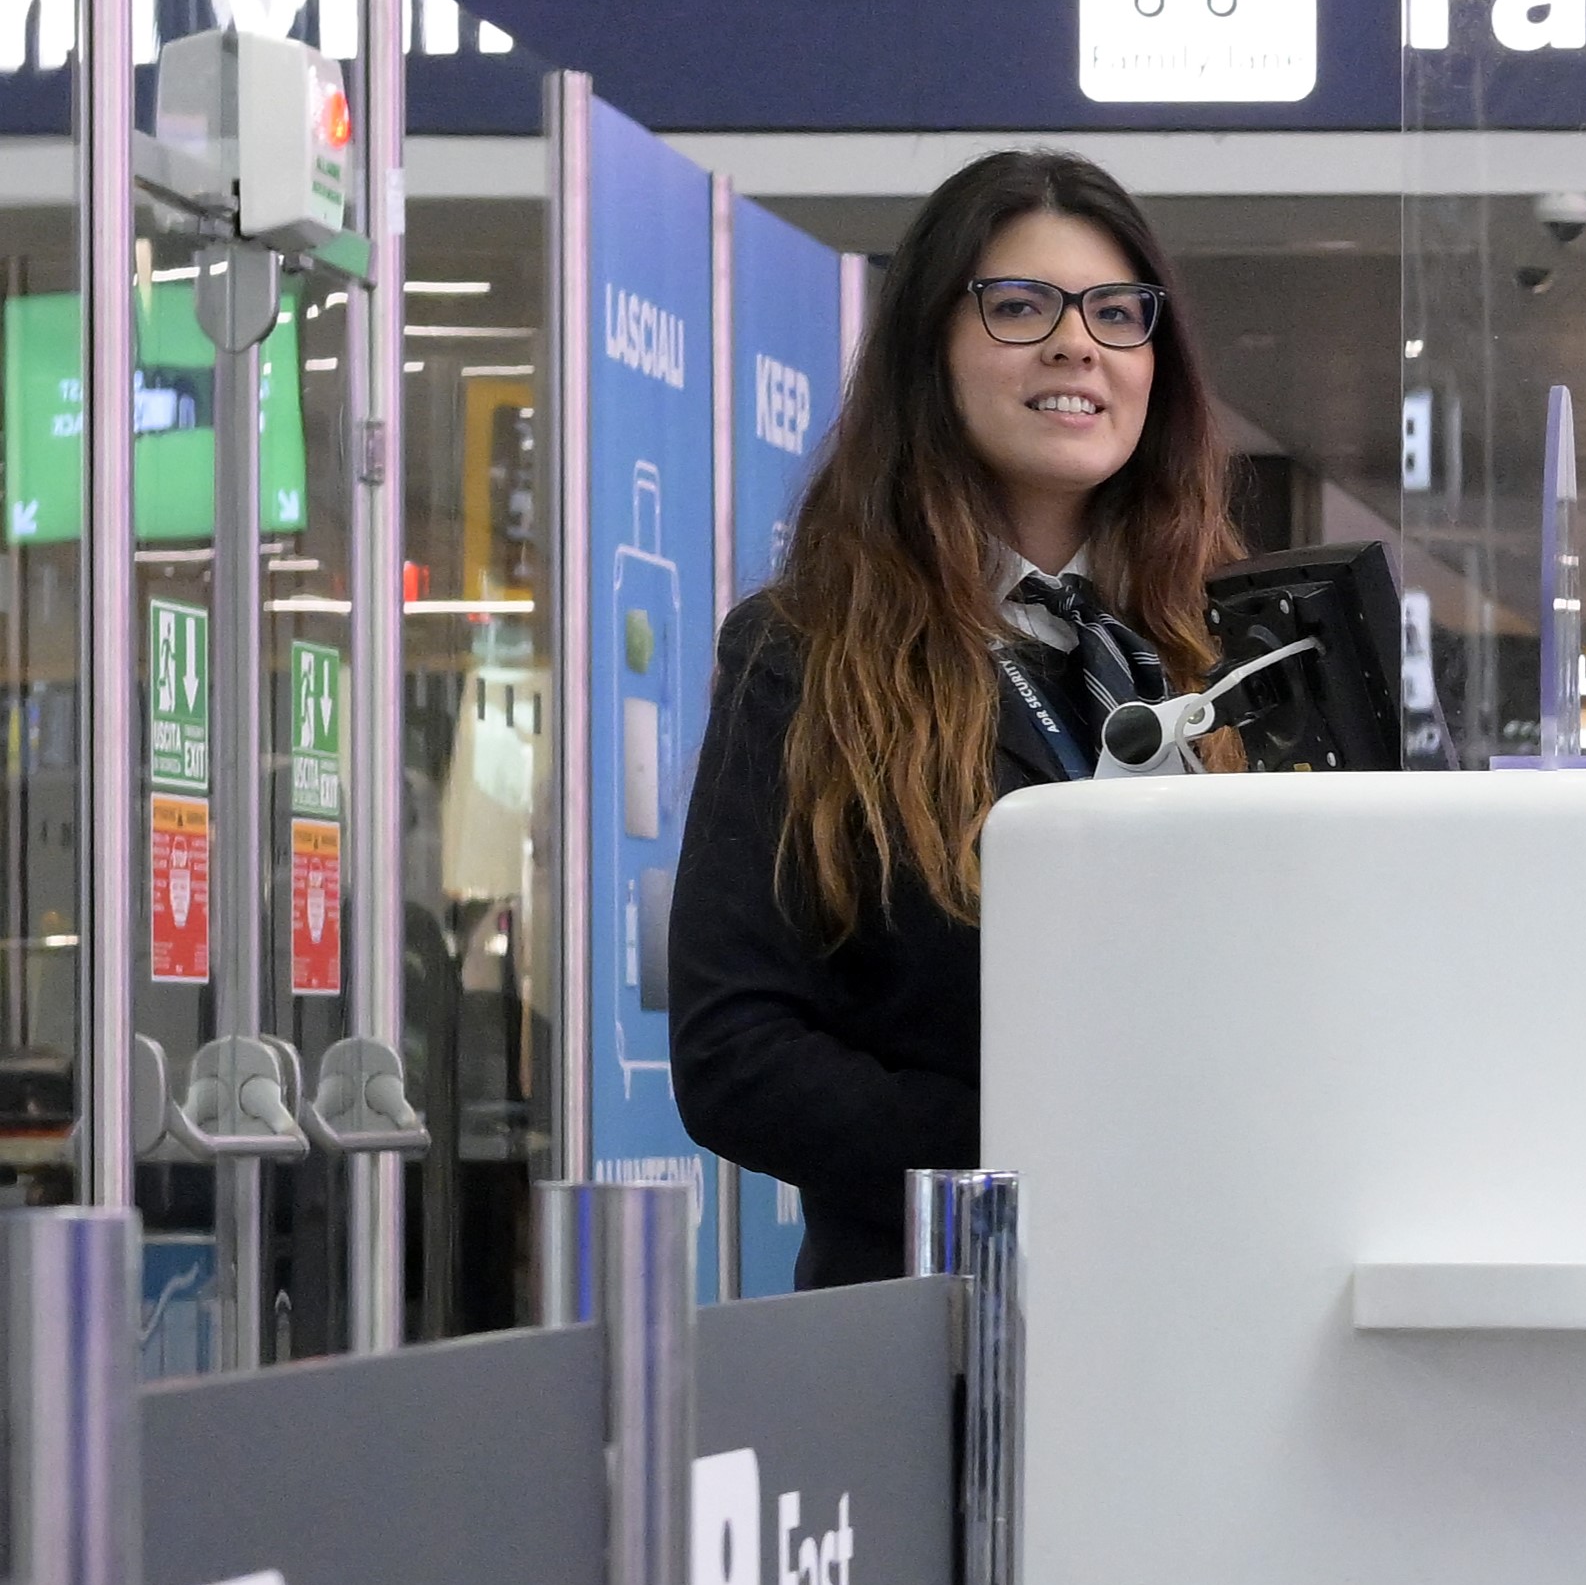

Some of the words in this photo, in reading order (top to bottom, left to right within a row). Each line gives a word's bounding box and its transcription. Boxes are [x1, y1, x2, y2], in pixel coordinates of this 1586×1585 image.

[605, 282, 684, 391] LASCIALI
[756, 352, 811, 455] KEEP
[999, 659, 1043, 709] SECURITY
[1036, 709, 1061, 733] ADR
